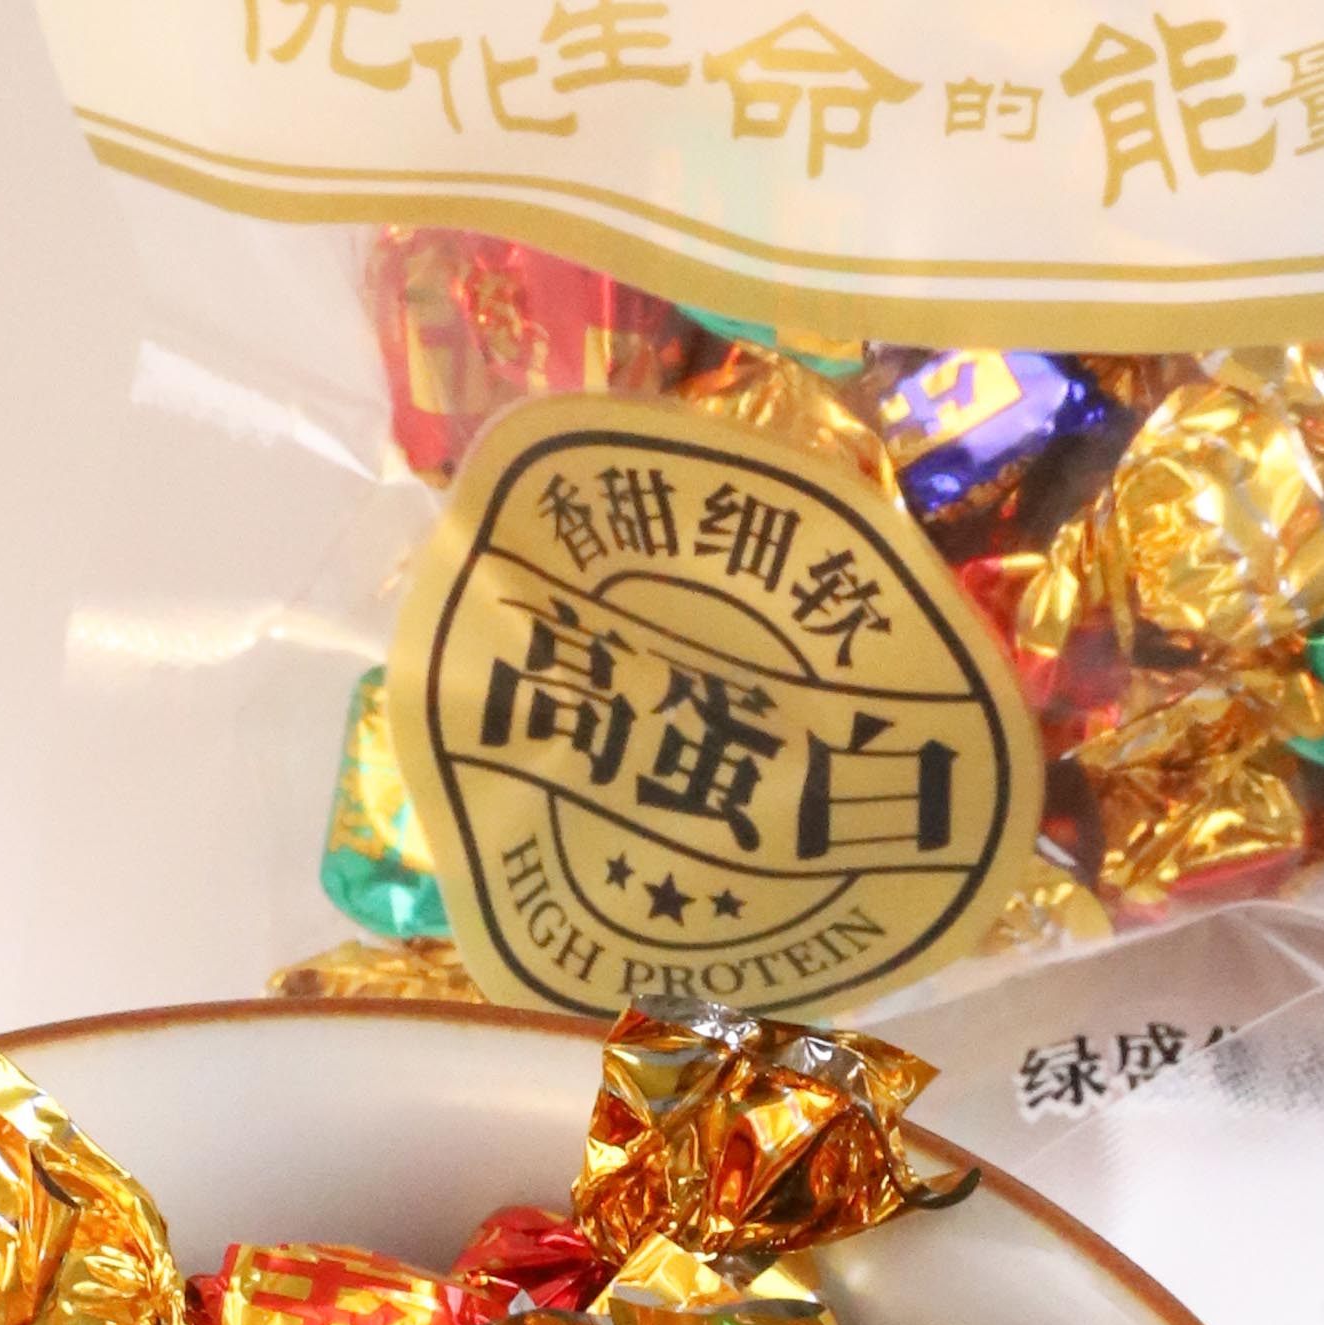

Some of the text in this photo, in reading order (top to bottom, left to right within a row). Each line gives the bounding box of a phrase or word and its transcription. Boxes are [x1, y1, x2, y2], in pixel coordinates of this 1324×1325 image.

[537, 464, 891, 668] 香甜细软
[478, 597, 960, 860] 高蛋白
[500, 833, 887, 1000] HIGH PROTEIN
[1020, 1022, 1238, 1107] 绿盛
